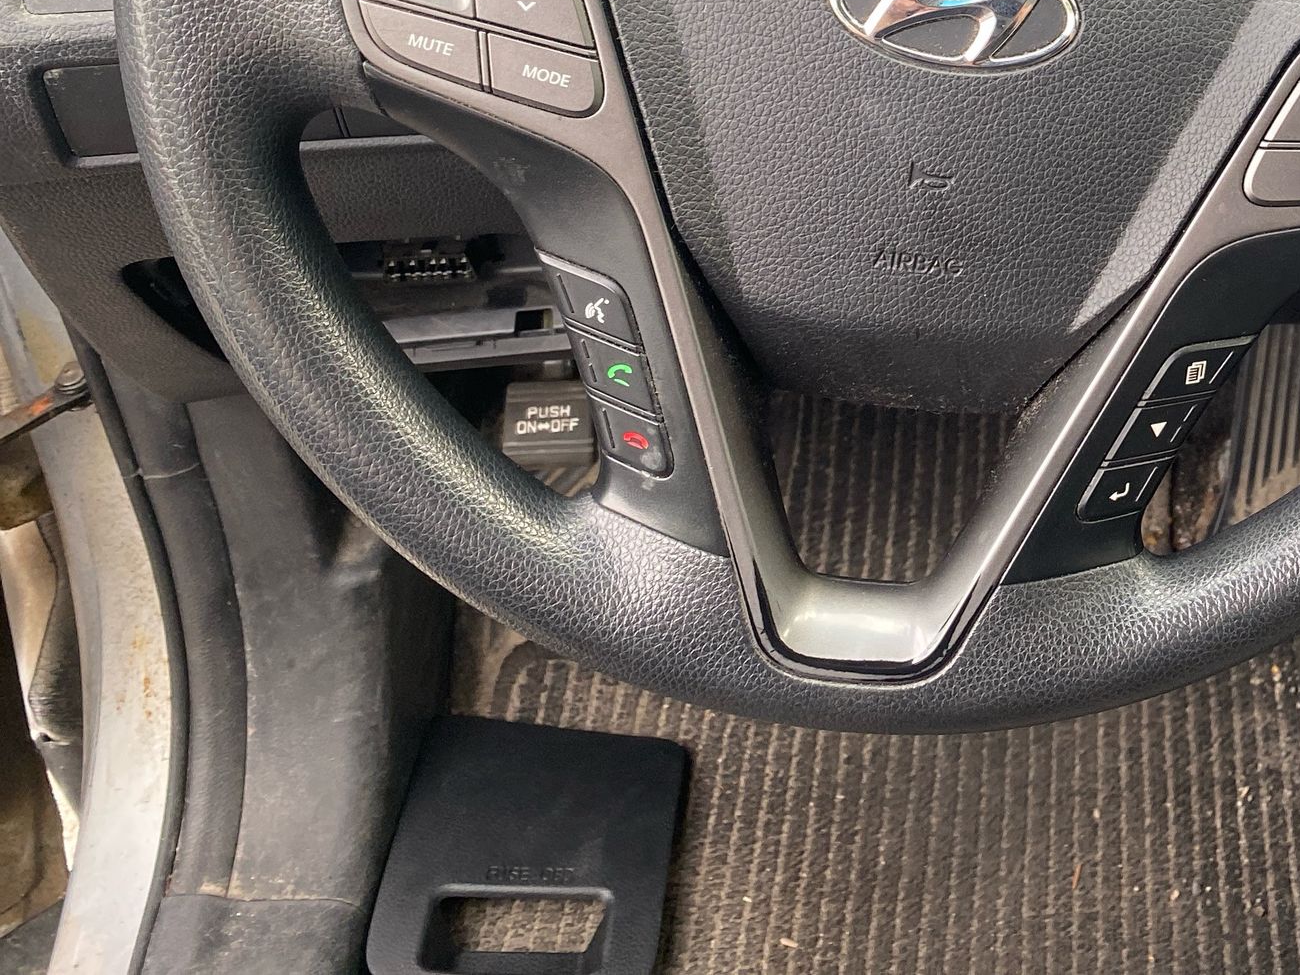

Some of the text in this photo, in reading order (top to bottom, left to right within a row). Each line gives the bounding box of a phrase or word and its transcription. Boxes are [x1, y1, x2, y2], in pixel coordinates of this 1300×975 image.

[407, 33, 455, 56] MUTE
[521, 64, 571, 88] MODE
[873, 250, 963, 275] AIRBAG
[527, 405, 570, 418] PUSH
[516, 418, 579, 435] ON OFF
